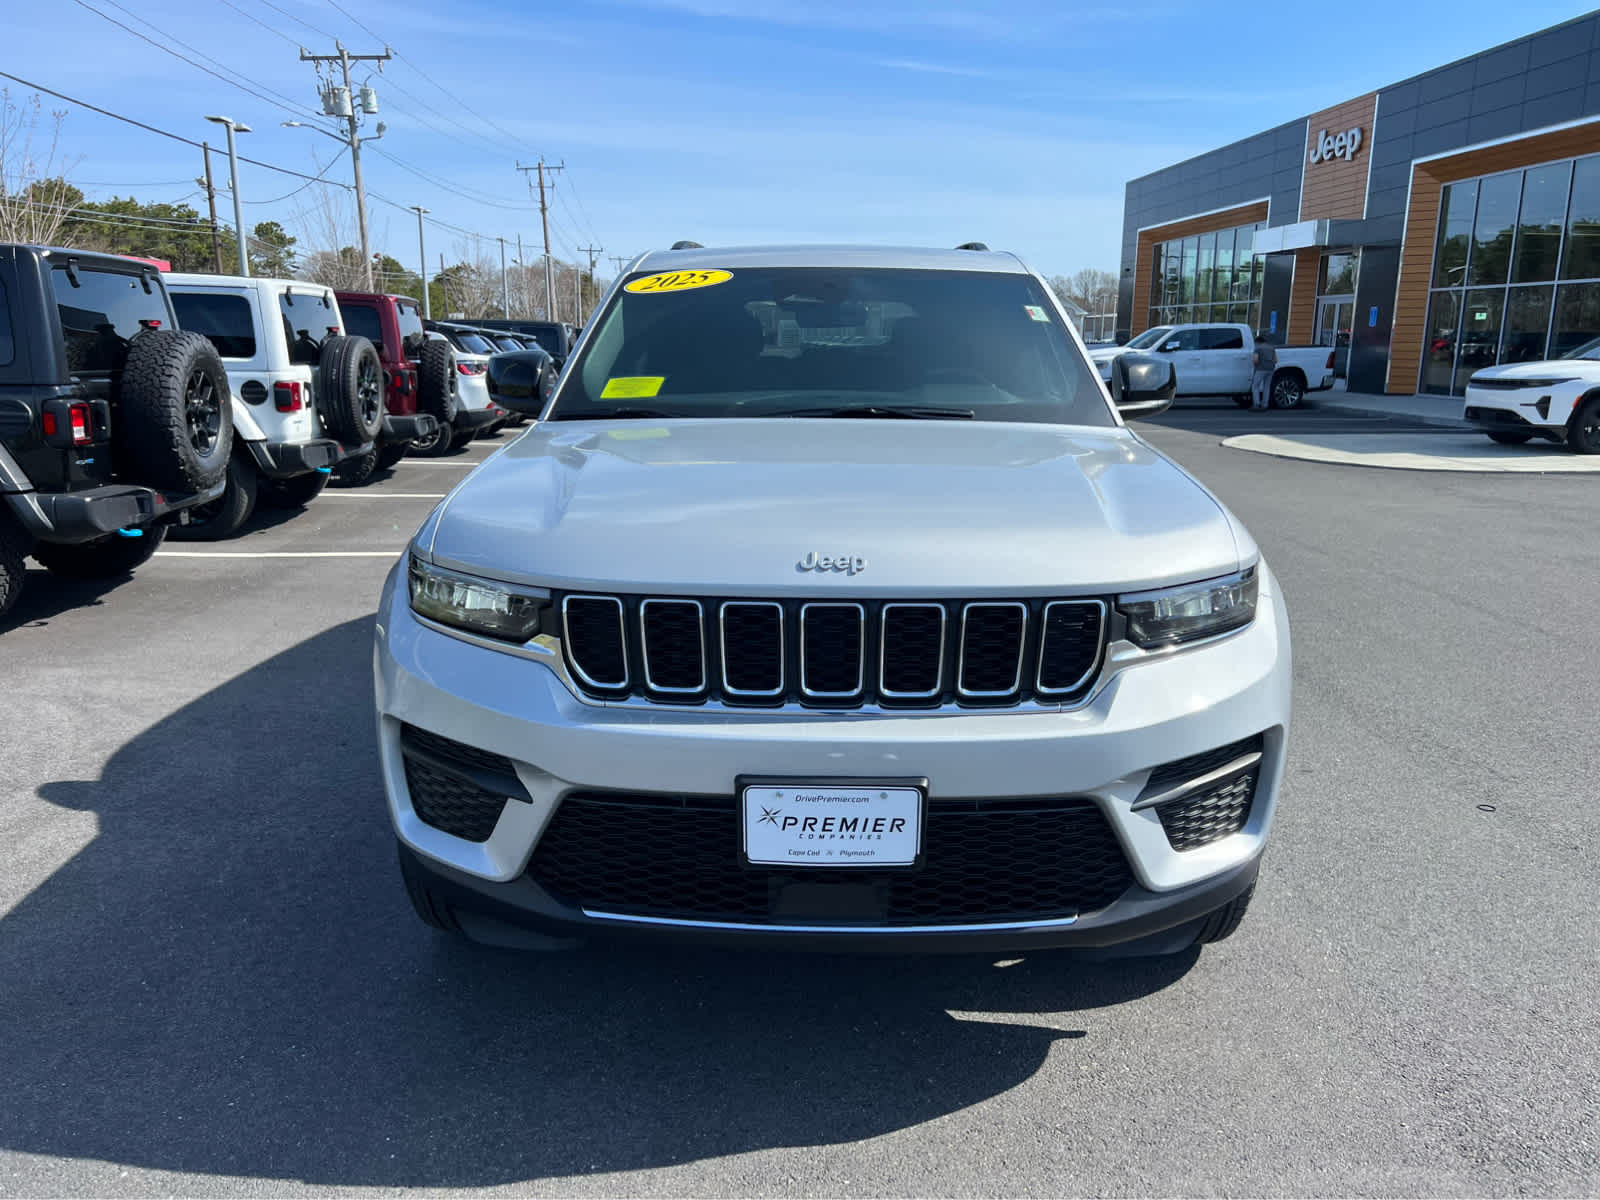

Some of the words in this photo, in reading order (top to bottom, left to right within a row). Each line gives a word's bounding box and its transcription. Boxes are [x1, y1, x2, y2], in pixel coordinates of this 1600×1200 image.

[1310, 128, 1362, 164] Jeep
[640, 271, 715, 291] 2025
[796, 552, 868, 576] Jeep
[795, 794, 870, 804] DrivePremier.com
[781, 816, 906, 833] PREMIER
[799, 833, 882, 841] COMPANIES
[788, 849, 806, 857] Cape
[839, 849, 876, 857] Plymouth
